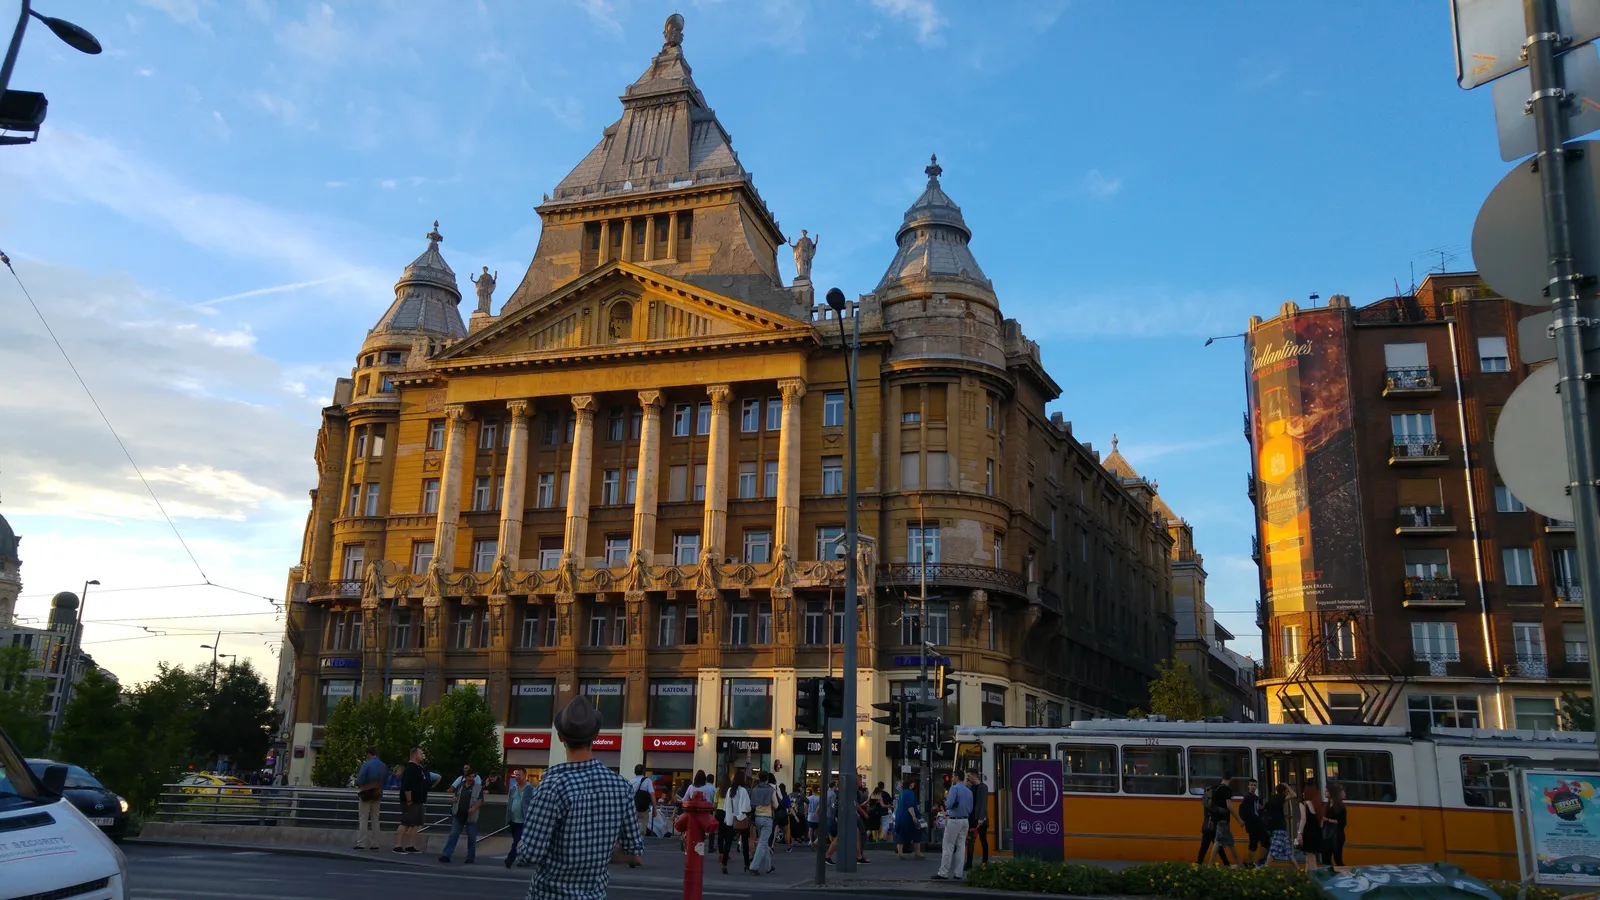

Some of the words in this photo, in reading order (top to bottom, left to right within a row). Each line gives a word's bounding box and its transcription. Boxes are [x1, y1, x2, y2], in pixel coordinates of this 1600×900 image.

[1250, 340, 1313, 373] Ballantine's
[1273, 358, 1299, 373] FIRED
[321, 658, 359, 668] KATED
[895, 656, 951, 666] KATEDA
[522, 686, 548, 694] KATEDRA
[662, 686, 688, 694] KATEDRA
[520, 736, 544, 744] vodafone
[592, 738, 614, 746] odafone
[661, 739, 687, 747] vodafone
[730, 740, 759, 750] ELMISZER
[1145, 737, 1160, 746] 1324
[807, 742, 822, 752] FOOD
[12, 836, 66, 849] SECURITY
